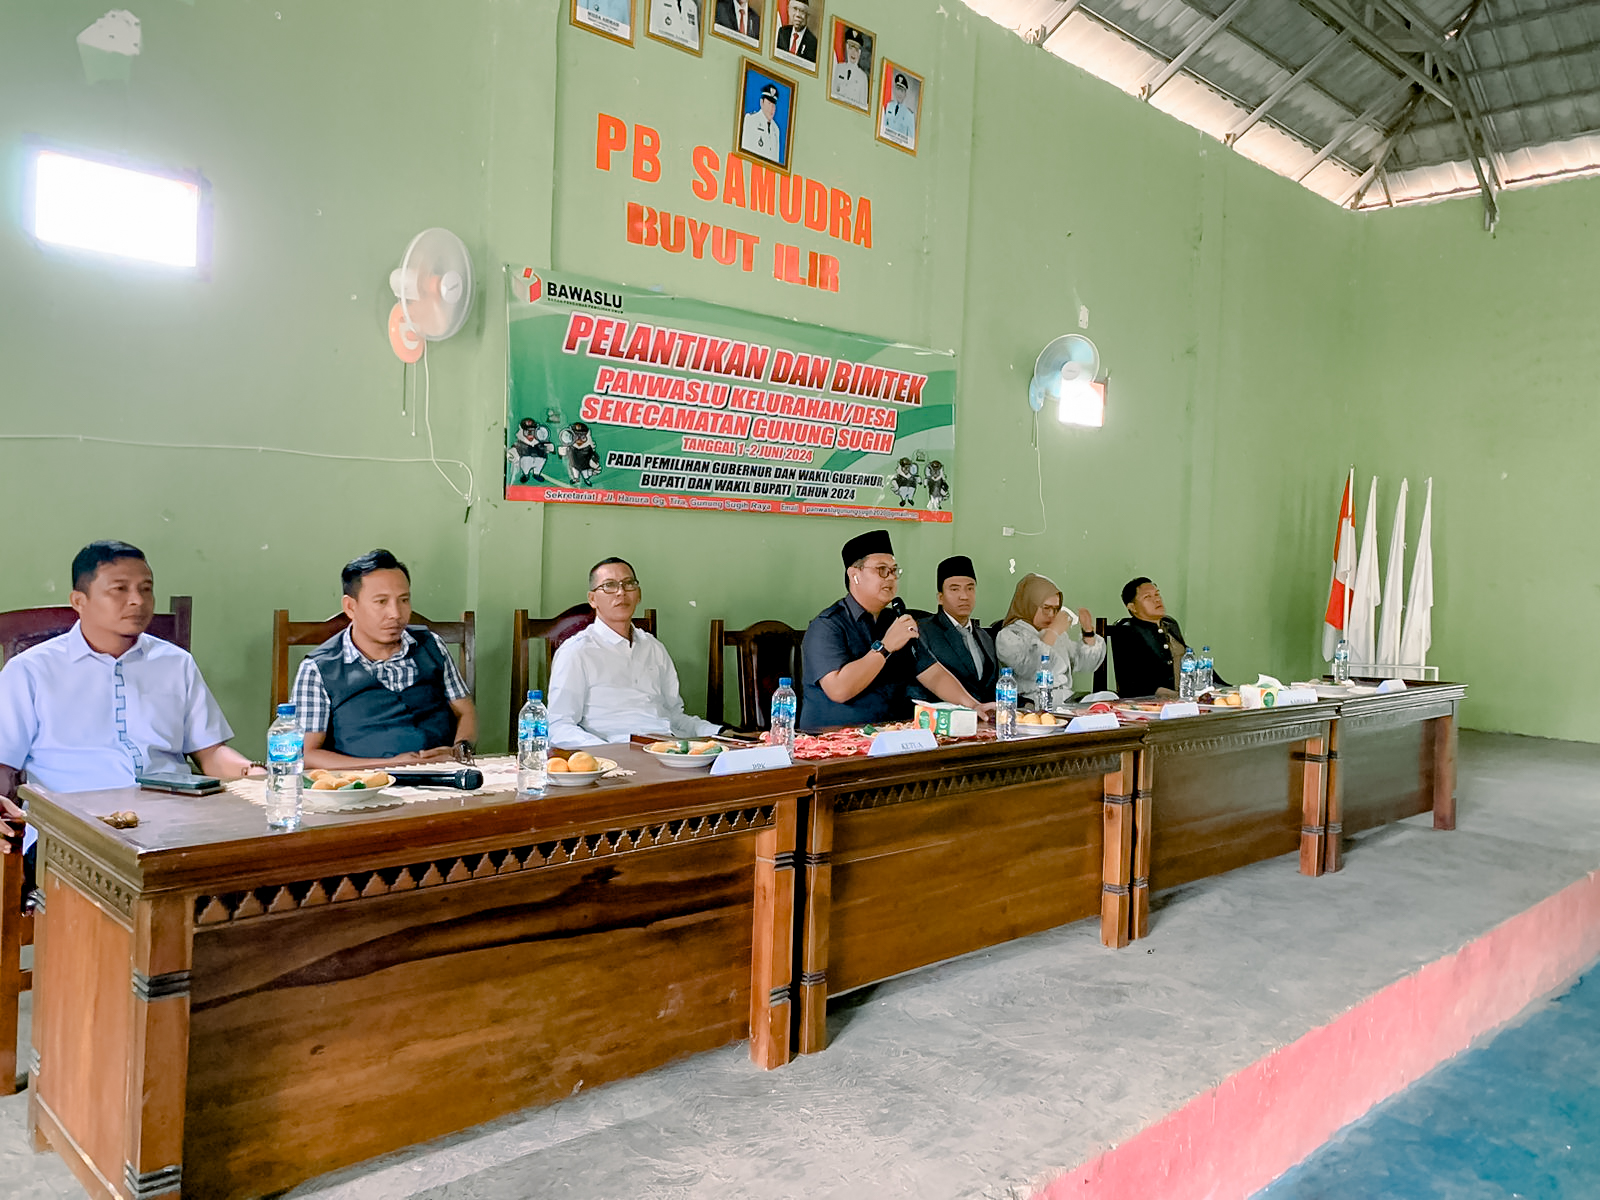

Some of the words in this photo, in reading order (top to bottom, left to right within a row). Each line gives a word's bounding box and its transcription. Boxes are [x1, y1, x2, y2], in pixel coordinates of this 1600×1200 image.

[596, 113, 662, 182] PB
[691, 146, 873, 248] SAMUDRA
[626, 202, 760, 272] BUYUT
[773, 243, 840, 292] ILIR
[547, 281, 622, 308] BAWASLU
[563, 312, 770, 382] PELANTIKAN
[769, 349, 831, 392] DAN
[830, 360, 927, 406] BIMTEK
[594, 366, 729, 408] PANWASLU
[729, 387, 897, 431] KELURAHAN/DESA
[580, 396, 751, 438] SEKECAMATAN
[752, 417, 835, 448] GUNUNG
[837, 428, 895, 454] SUGIH
[607, 452, 641, 468] PADA
[643, 455, 711, 474] PEMILIHAN
[712, 461, 773, 479] GUBERNUR
[774, 466, 797, 480] DAN
[798, 469, 831, 484] WAKIL
[682, 436, 736, 456] TANGGAL
[758, 445, 784, 459] JUNI
[784, 448, 813, 463] 2024
[545, 490, 596, 500] Sekretariat
[617, 494, 650, 504] Hanura
[690, 498, 723, 509] Gunung
[724, 500, 749, 511] Sugih
[750, 501, 771, 512] Raya
[640, 474, 685, 489] BUPATI
[687, 476, 712, 490] DAN
[714, 478, 751, 494] WAKIL
[753, 482, 791, 497] BUPATI
[795, 485, 829, 499] TAHUN
[829, 487, 856, 501] 2024
